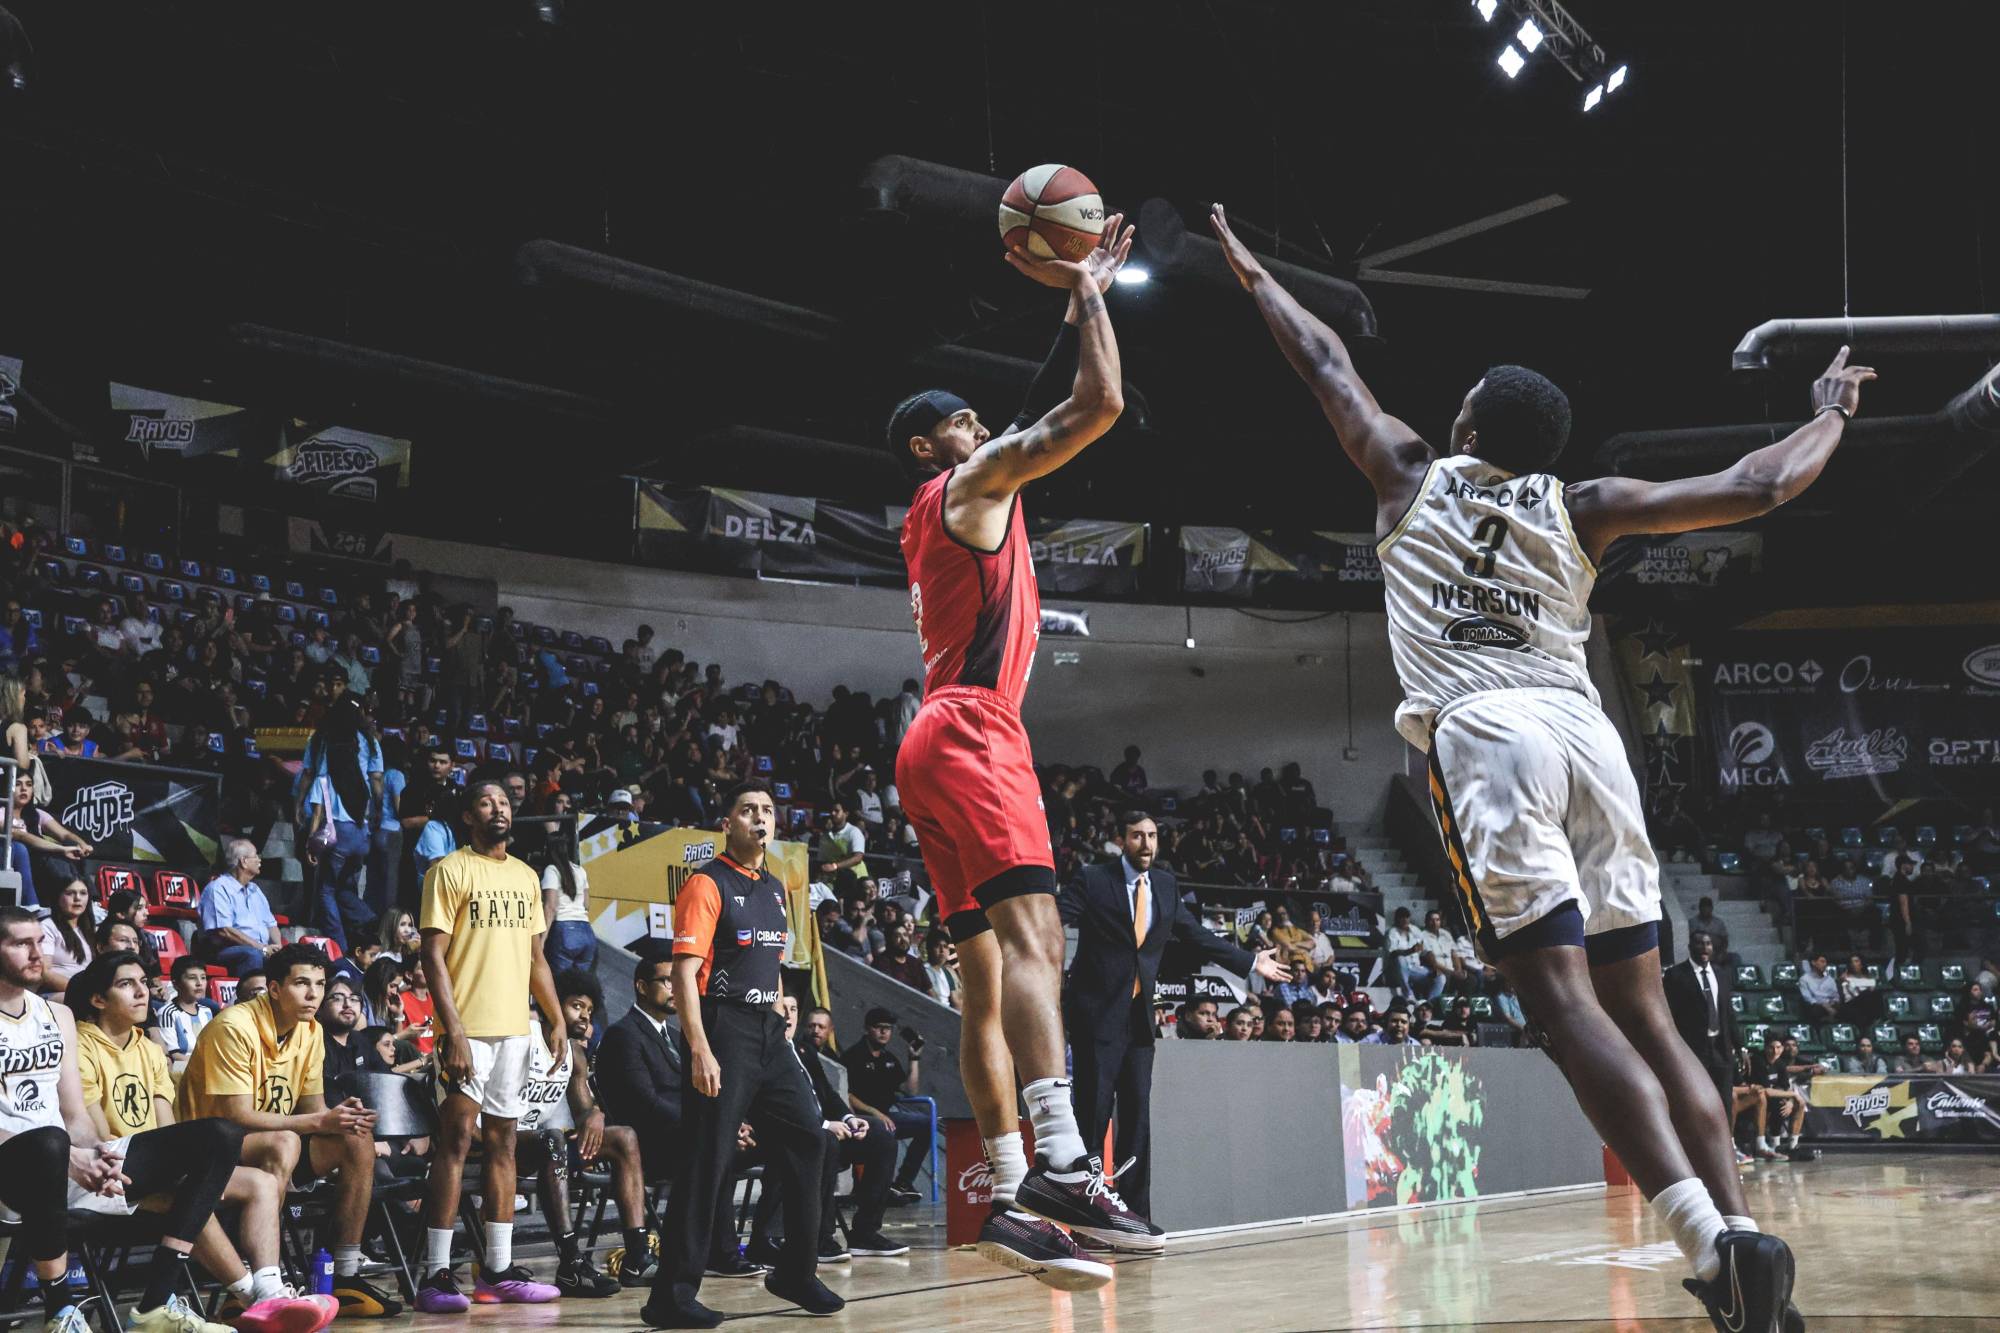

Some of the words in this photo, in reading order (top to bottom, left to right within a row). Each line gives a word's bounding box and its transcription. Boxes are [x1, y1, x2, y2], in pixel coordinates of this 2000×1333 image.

[128, 415, 194, 441] RAYOS
[303, 450, 367, 473] PIPESO
[725, 514, 816, 544] DELZA
[1031, 540, 1118, 566] DELZA
[1463, 515, 1508, 578] 3
[1647, 546, 1688, 559] HIELO
[1199, 547, 1248, 569] RAYOS
[1645, 559, 1690, 571] POLAR
[1637, 571, 1699, 584] SONORA
[1432, 582, 1540, 621] IVERSON
[1714, 662, 1794, 684] ARCO
[1720, 767, 1791, 785] MEGA
[683, 842, 715, 862] RAYOS
[469, 890, 532, 901] BASKETBAL
[470, 919, 528, 929] HERMOSIL
[1155, 980, 1186, 995] hevron
[1209, 982, 1232, 997] Chev
[13, 1100, 46, 1112] MEGA
[1847, 1094, 1889, 1112] RAYOS
[1927, 1091, 1986, 1110] Caliente
